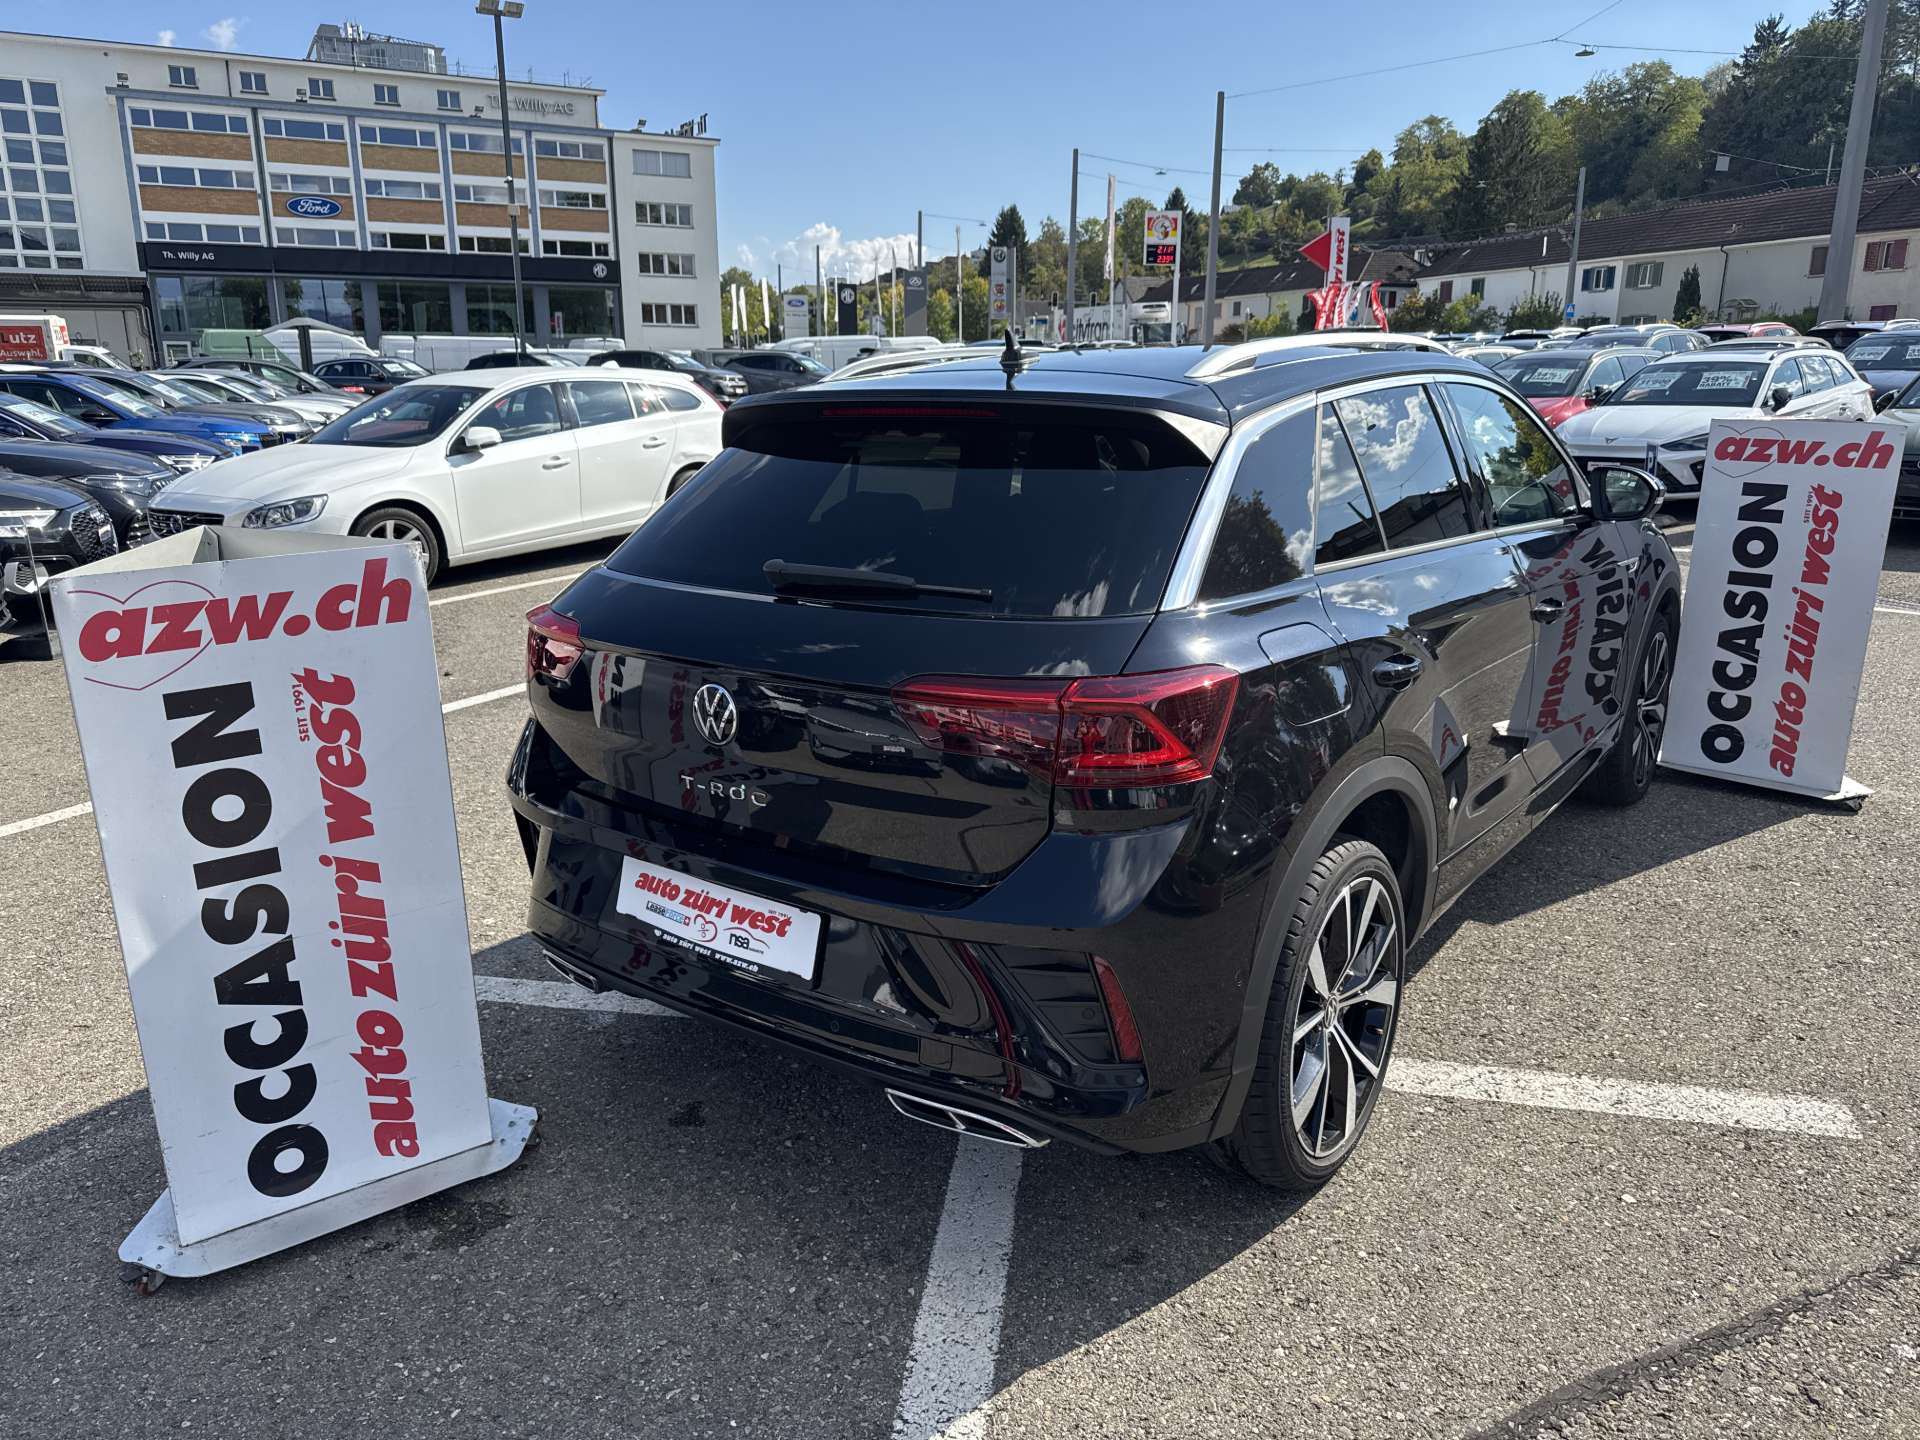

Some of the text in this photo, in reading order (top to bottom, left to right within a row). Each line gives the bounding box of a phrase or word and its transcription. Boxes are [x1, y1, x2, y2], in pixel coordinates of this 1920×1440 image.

[514, 96, 551, 116] Willy
[554, 102, 575, 116] AG
[297, 199, 331, 213] Ford
[162, 251, 215, 262] Th. Willy AG
[1714, 431, 1895, 469] azw.ch
[78, 558, 412, 663] azw.ch
[1700, 481, 1788, 764] OCCASION
[1769, 483, 1843, 778] auto züri west
[293, 682, 310, 742] SEIT 1991
[291, 666, 420, 1158] auto züri west
[635, 872, 792, 938] auto züri west
[162, 681, 329, 1198] OCCASION
[662, 933, 759, 973] auto züri west www.azw.ch
[729, 933, 750, 950] nsa
